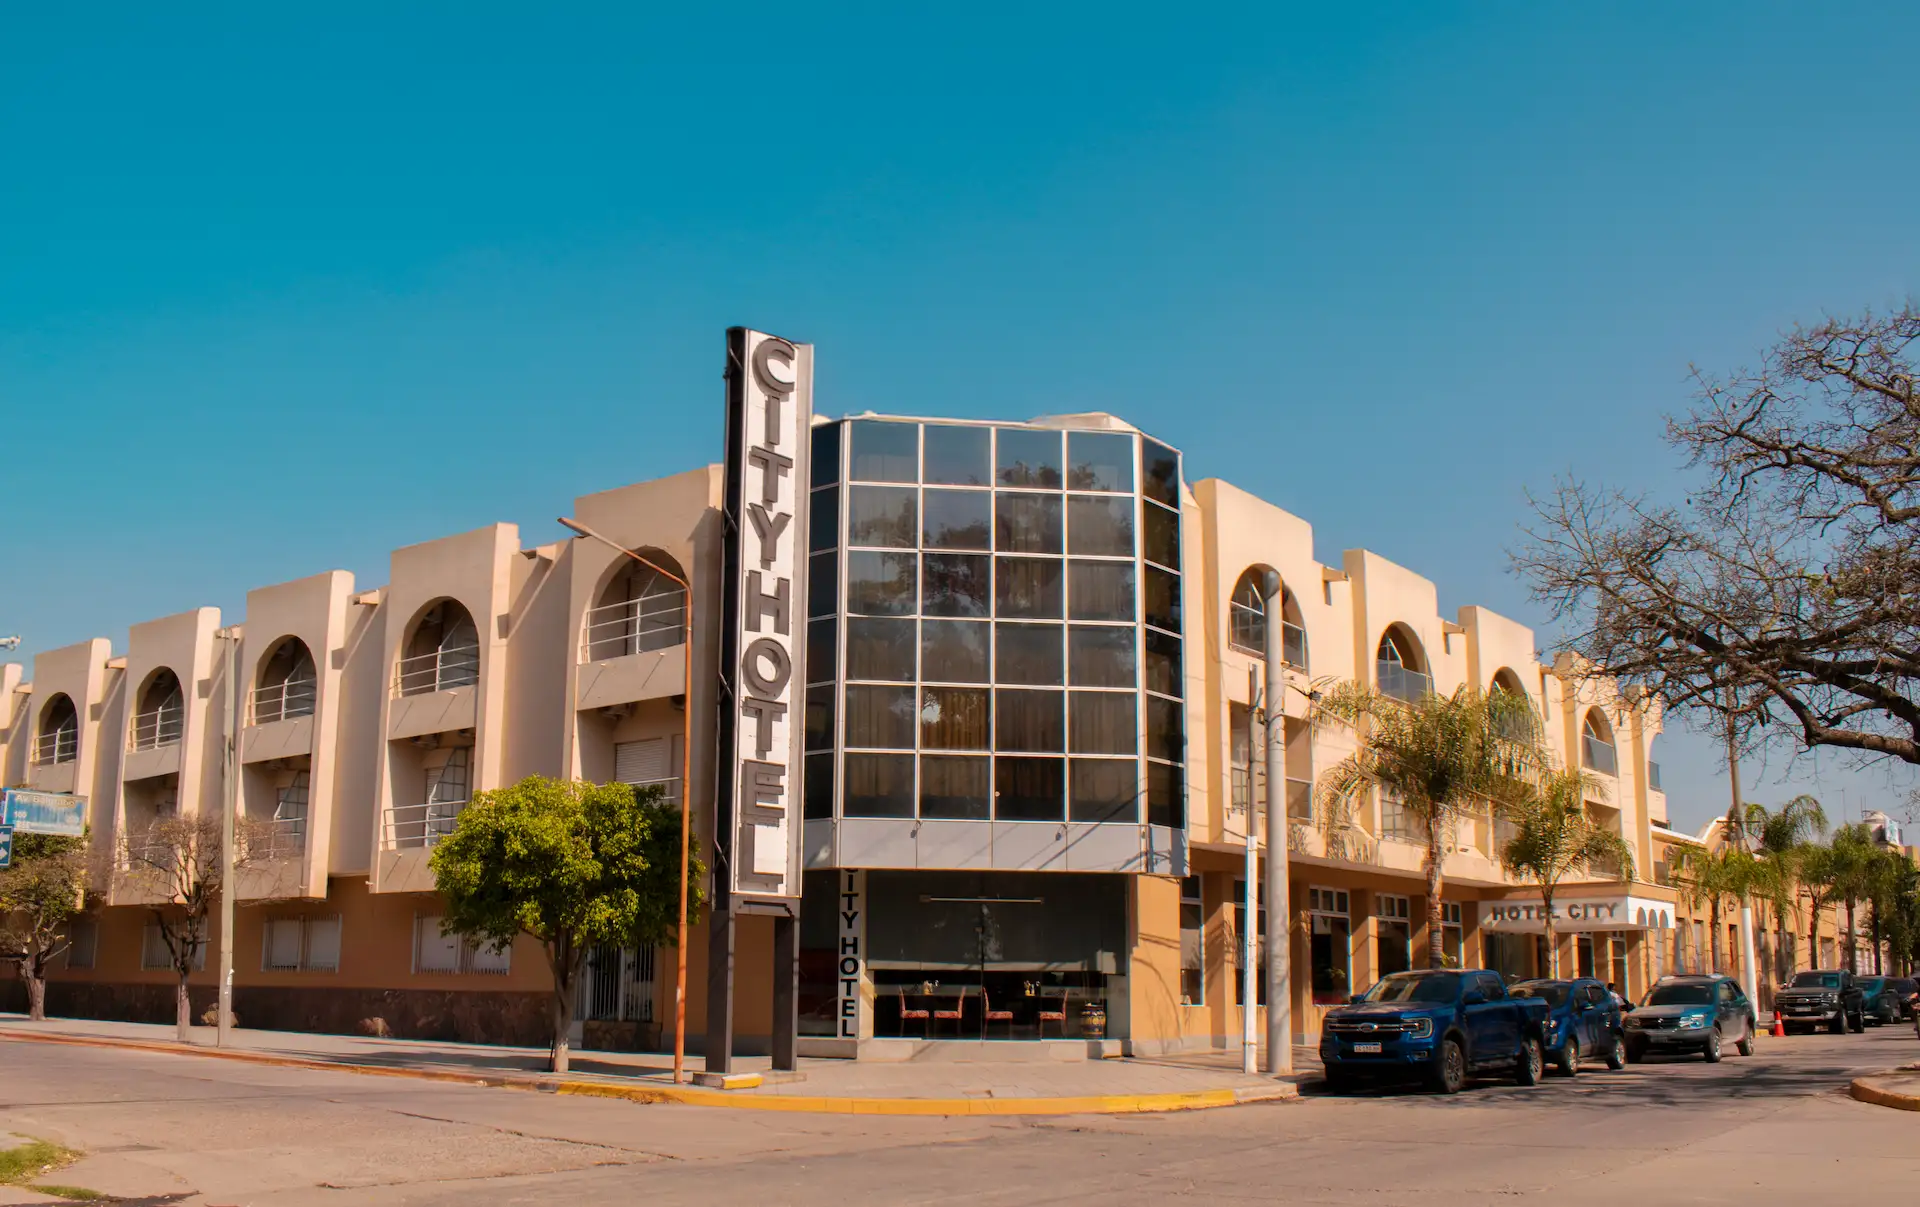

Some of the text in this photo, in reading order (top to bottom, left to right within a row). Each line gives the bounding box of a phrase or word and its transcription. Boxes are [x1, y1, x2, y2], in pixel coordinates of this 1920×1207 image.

[741, 337, 796, 891] CITY HOTEL
[840, 868, 859, 1037] ITY HOTEL
[1567, 902, 1618, 920] CITY
